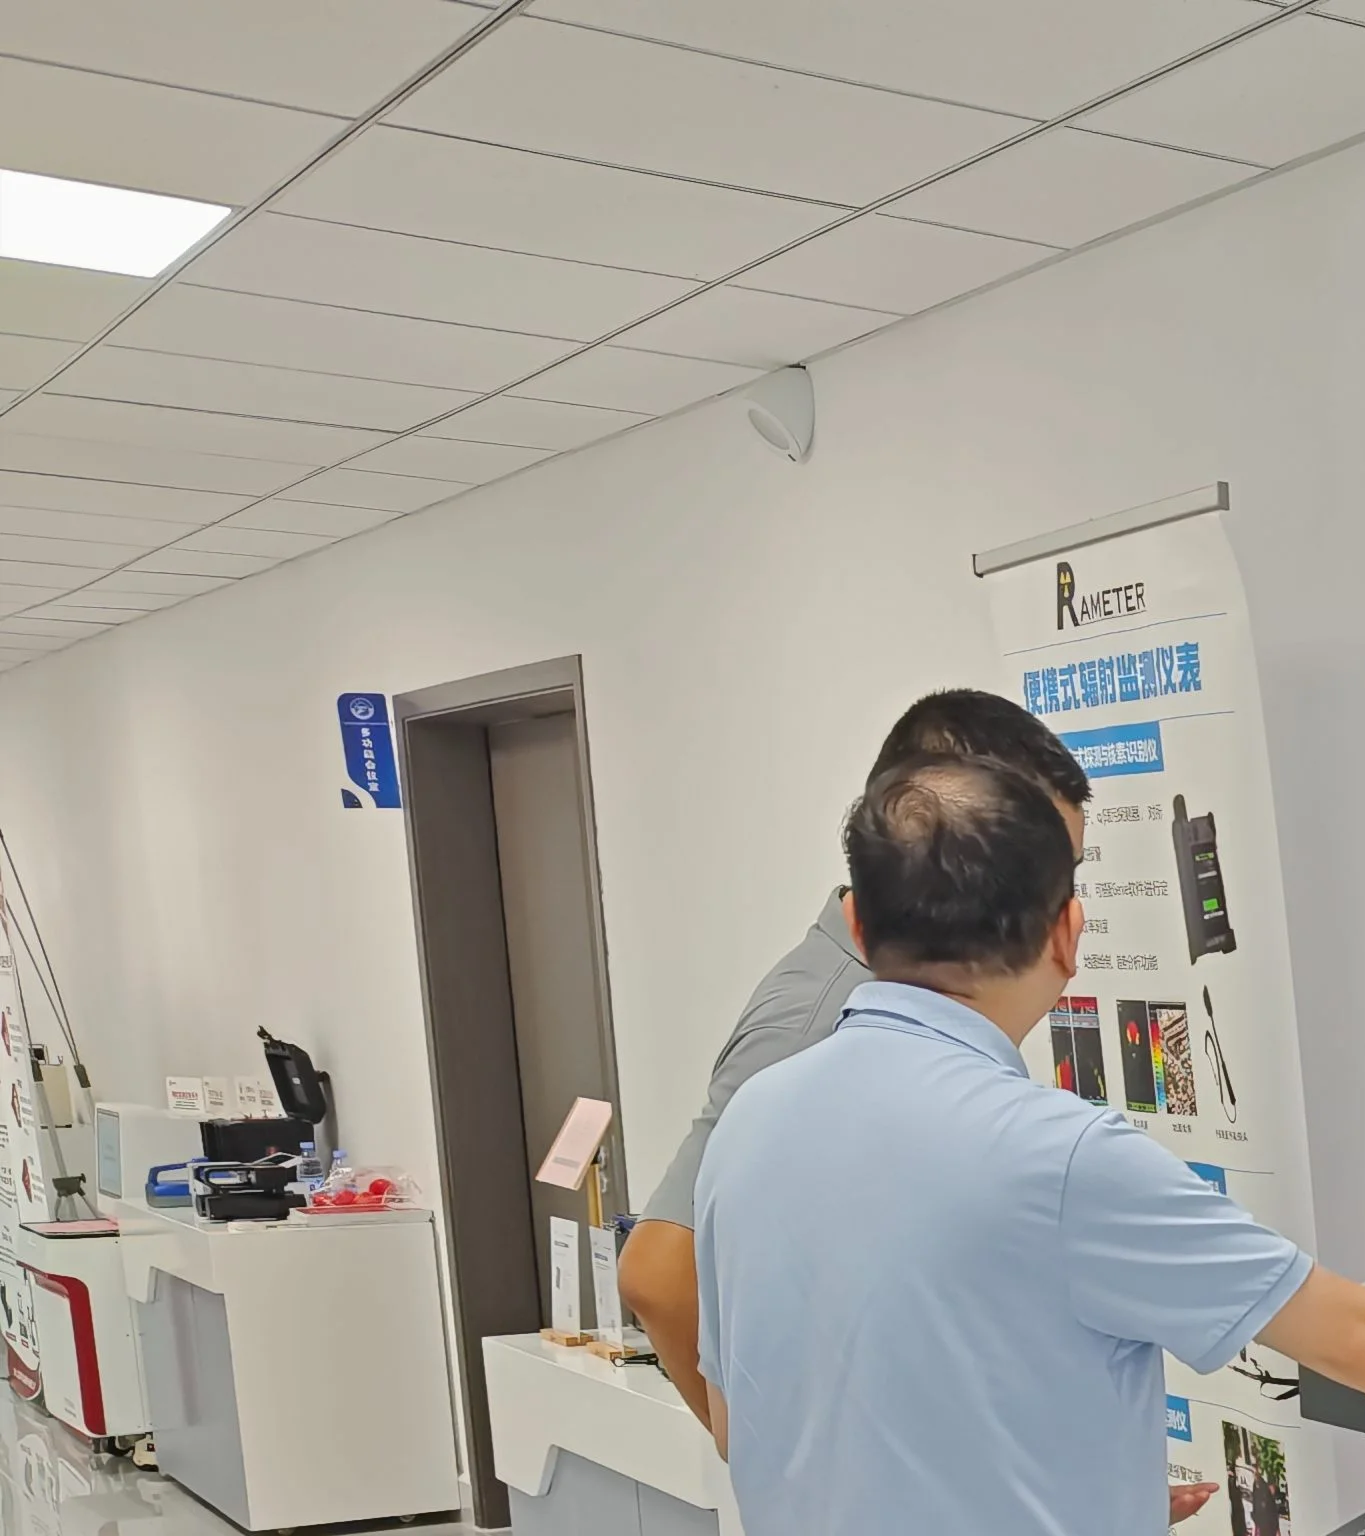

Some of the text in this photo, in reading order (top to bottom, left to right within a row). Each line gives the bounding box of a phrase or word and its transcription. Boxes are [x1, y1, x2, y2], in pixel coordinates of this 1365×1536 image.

[1057, 562, 1147, 630] RAMETER
[1023, 642, 1202, 716] 便携式辐射监测仪表
